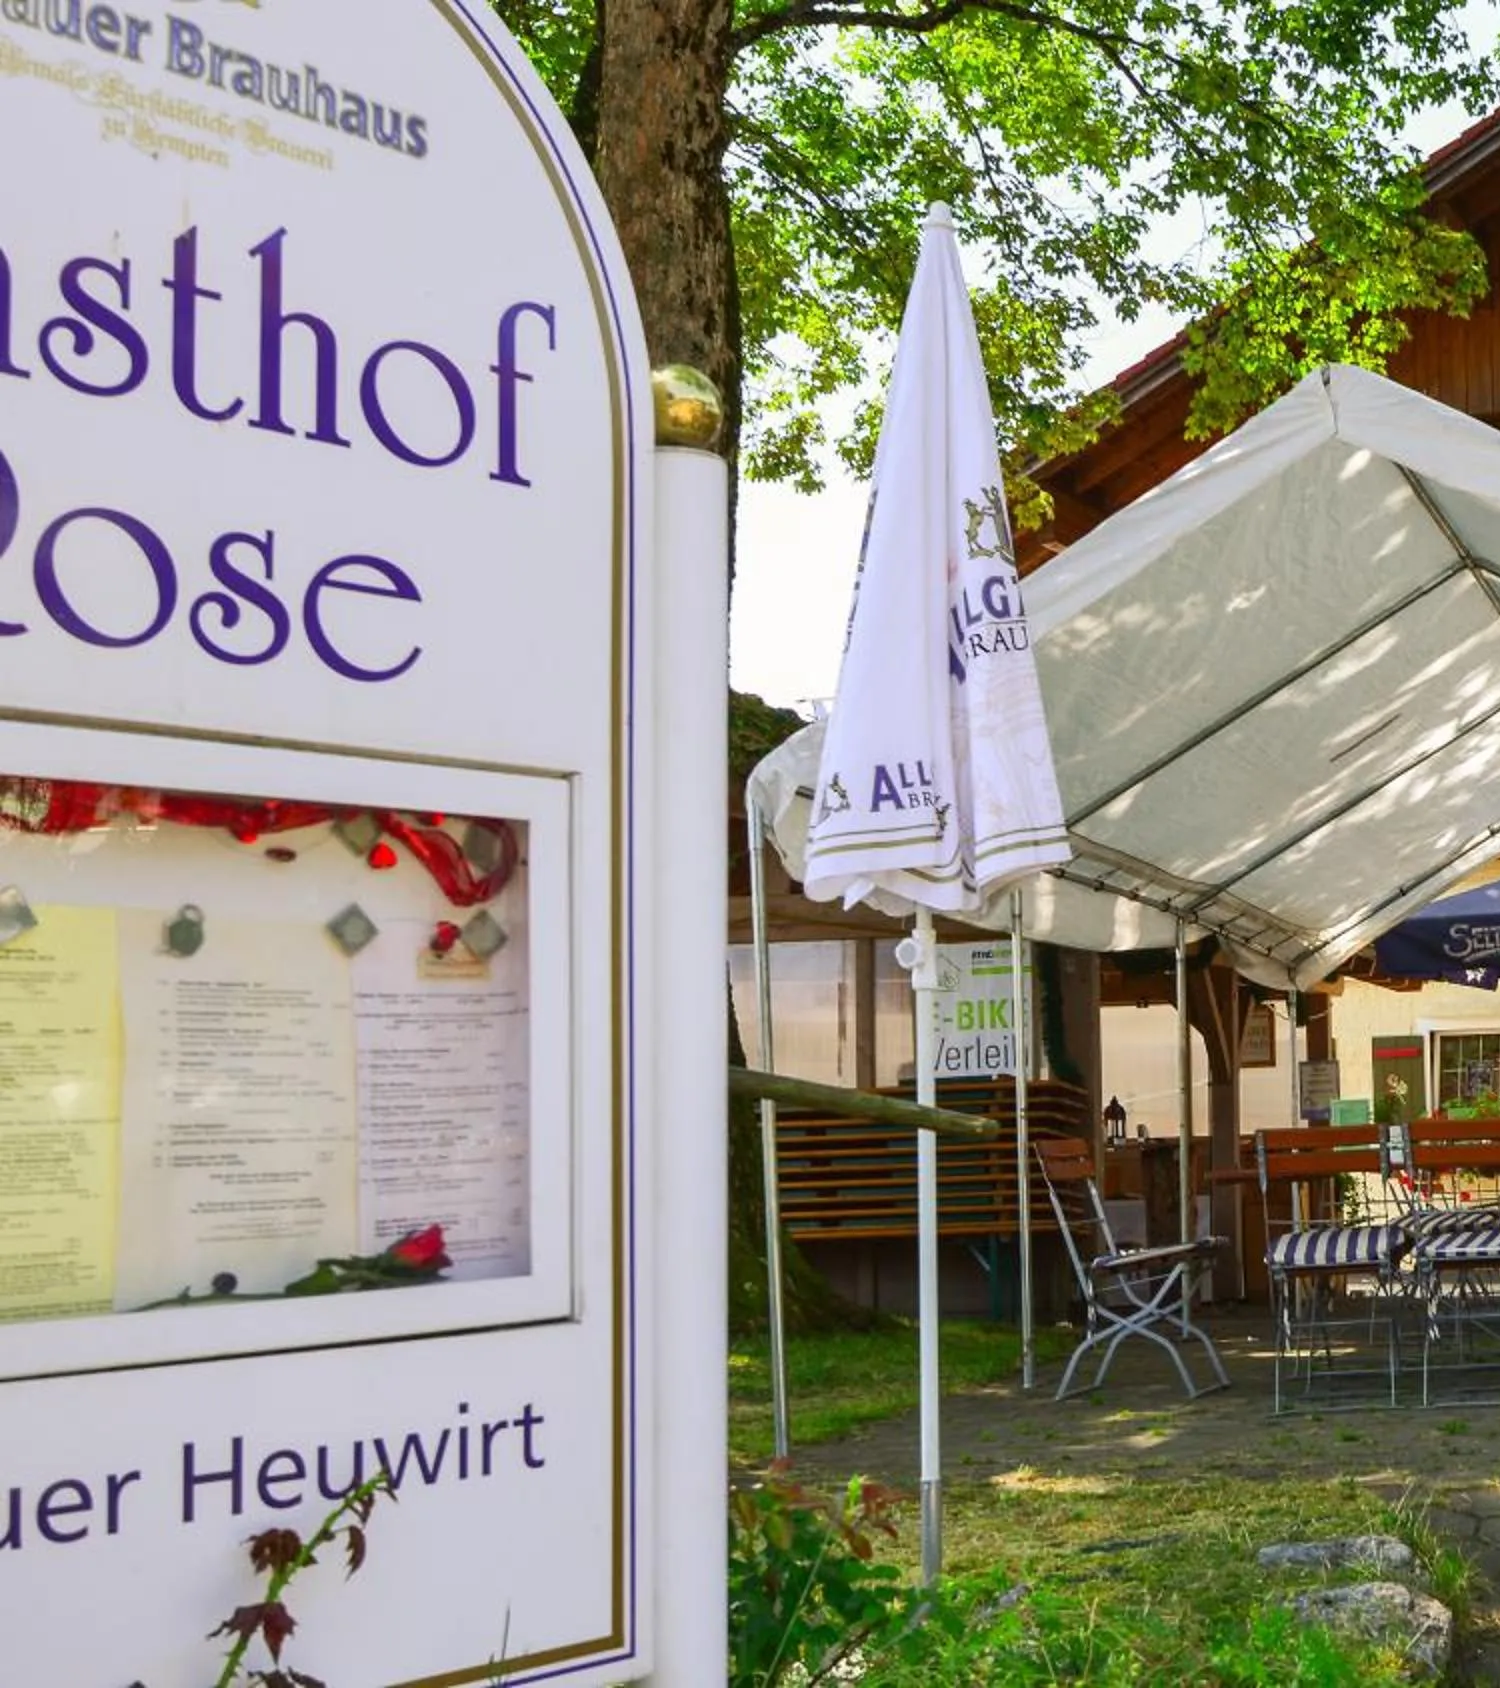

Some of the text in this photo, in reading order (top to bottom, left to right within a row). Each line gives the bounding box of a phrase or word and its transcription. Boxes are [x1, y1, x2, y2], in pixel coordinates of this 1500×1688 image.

[165, 14, 428, 160] Brauhaus
[0, 226, 556, 487] sthof
[0, 449, 422, 683] ose
[965, 625, 1029, 658] RAU
[934, 1000, 1028, 1032] -BIK
[181, 1402, 546, 1523] Heuwirt
